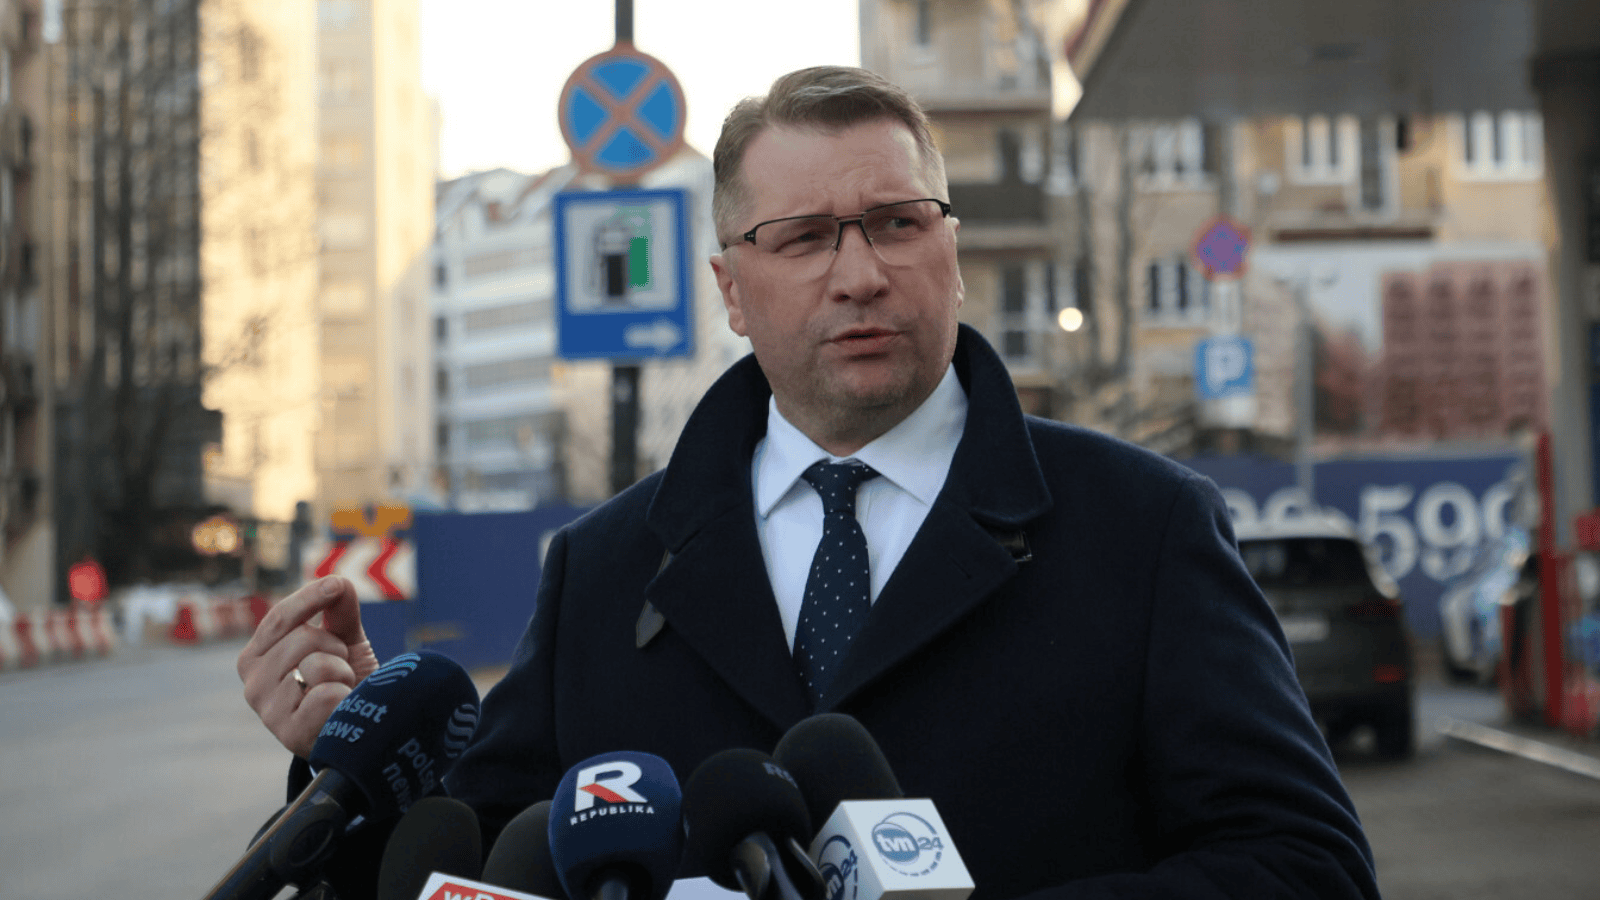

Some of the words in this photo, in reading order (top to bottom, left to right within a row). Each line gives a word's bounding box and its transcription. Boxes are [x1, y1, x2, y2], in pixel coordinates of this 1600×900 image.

[1207, 344, 1245, 394] P
[336, 694, 387, 723] olsat
[575, 761, 648, 812] R
[570, 804, 654, 825] REPUBLIKA
